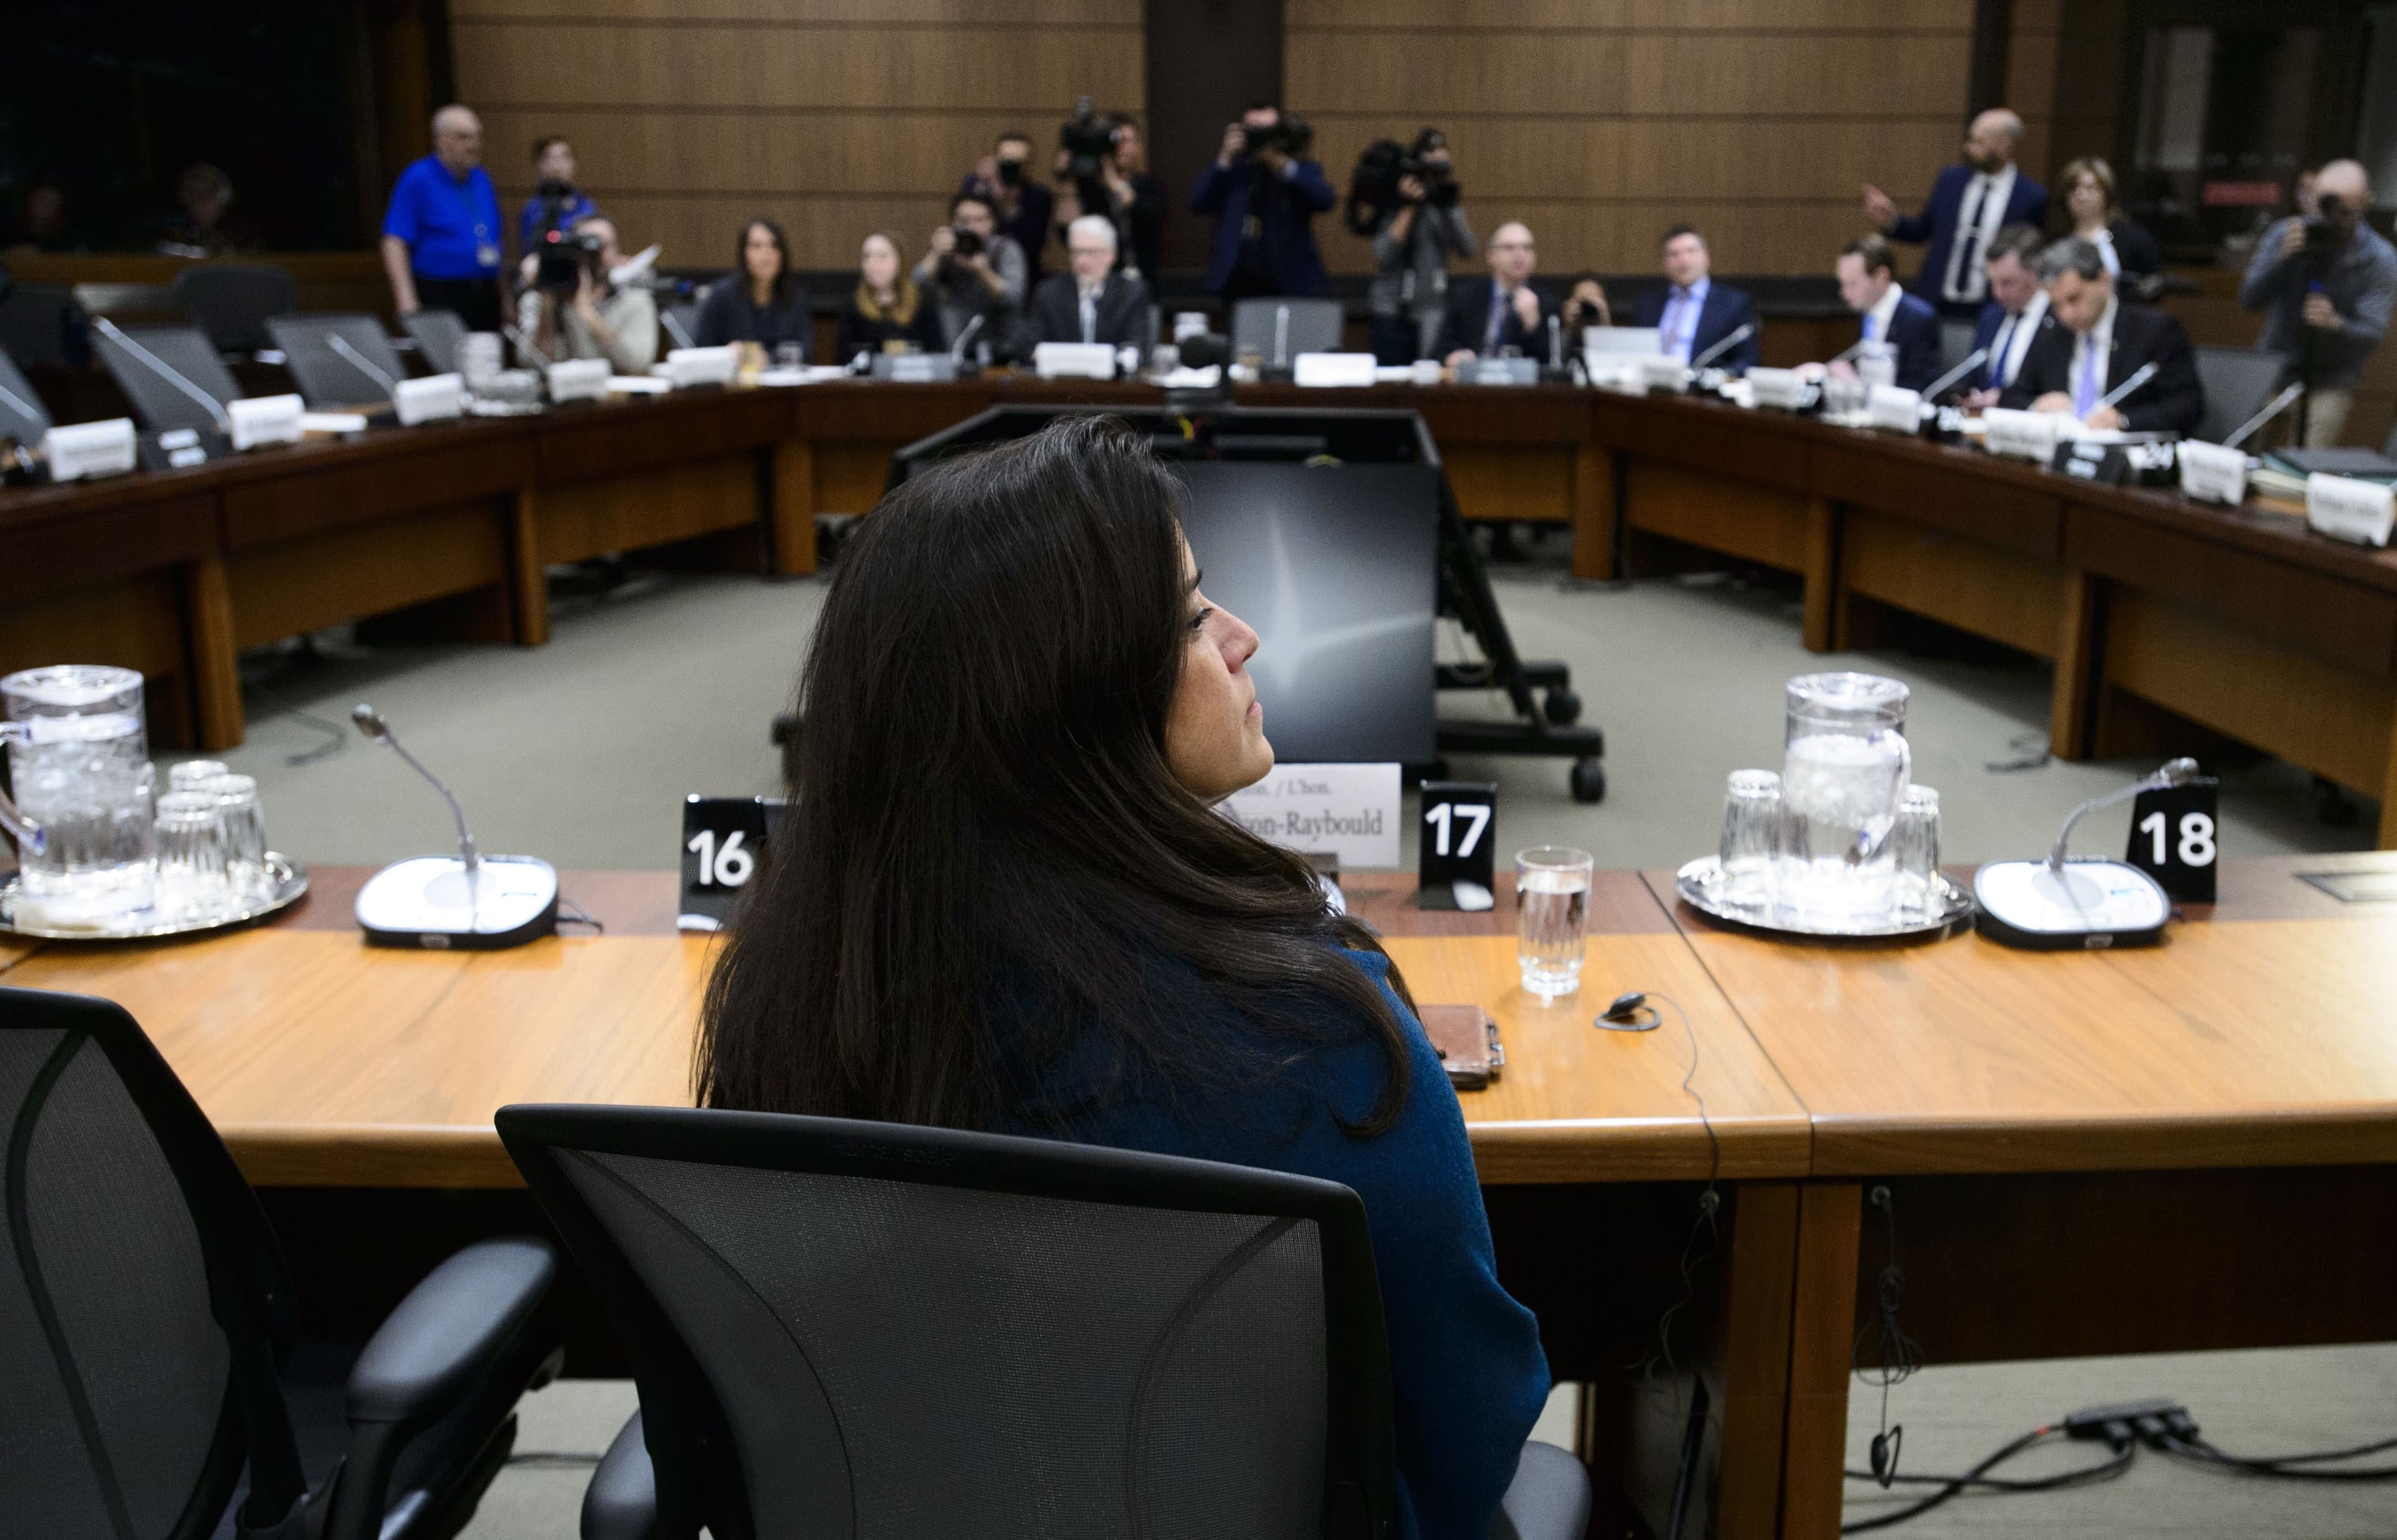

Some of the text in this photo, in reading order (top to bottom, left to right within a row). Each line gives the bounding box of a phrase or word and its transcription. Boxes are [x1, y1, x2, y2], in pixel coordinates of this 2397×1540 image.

[1426, 803, 1491, 857] 17
[2140, 812, 2216, 867] 18
[687, 830, 754, 887] 16
